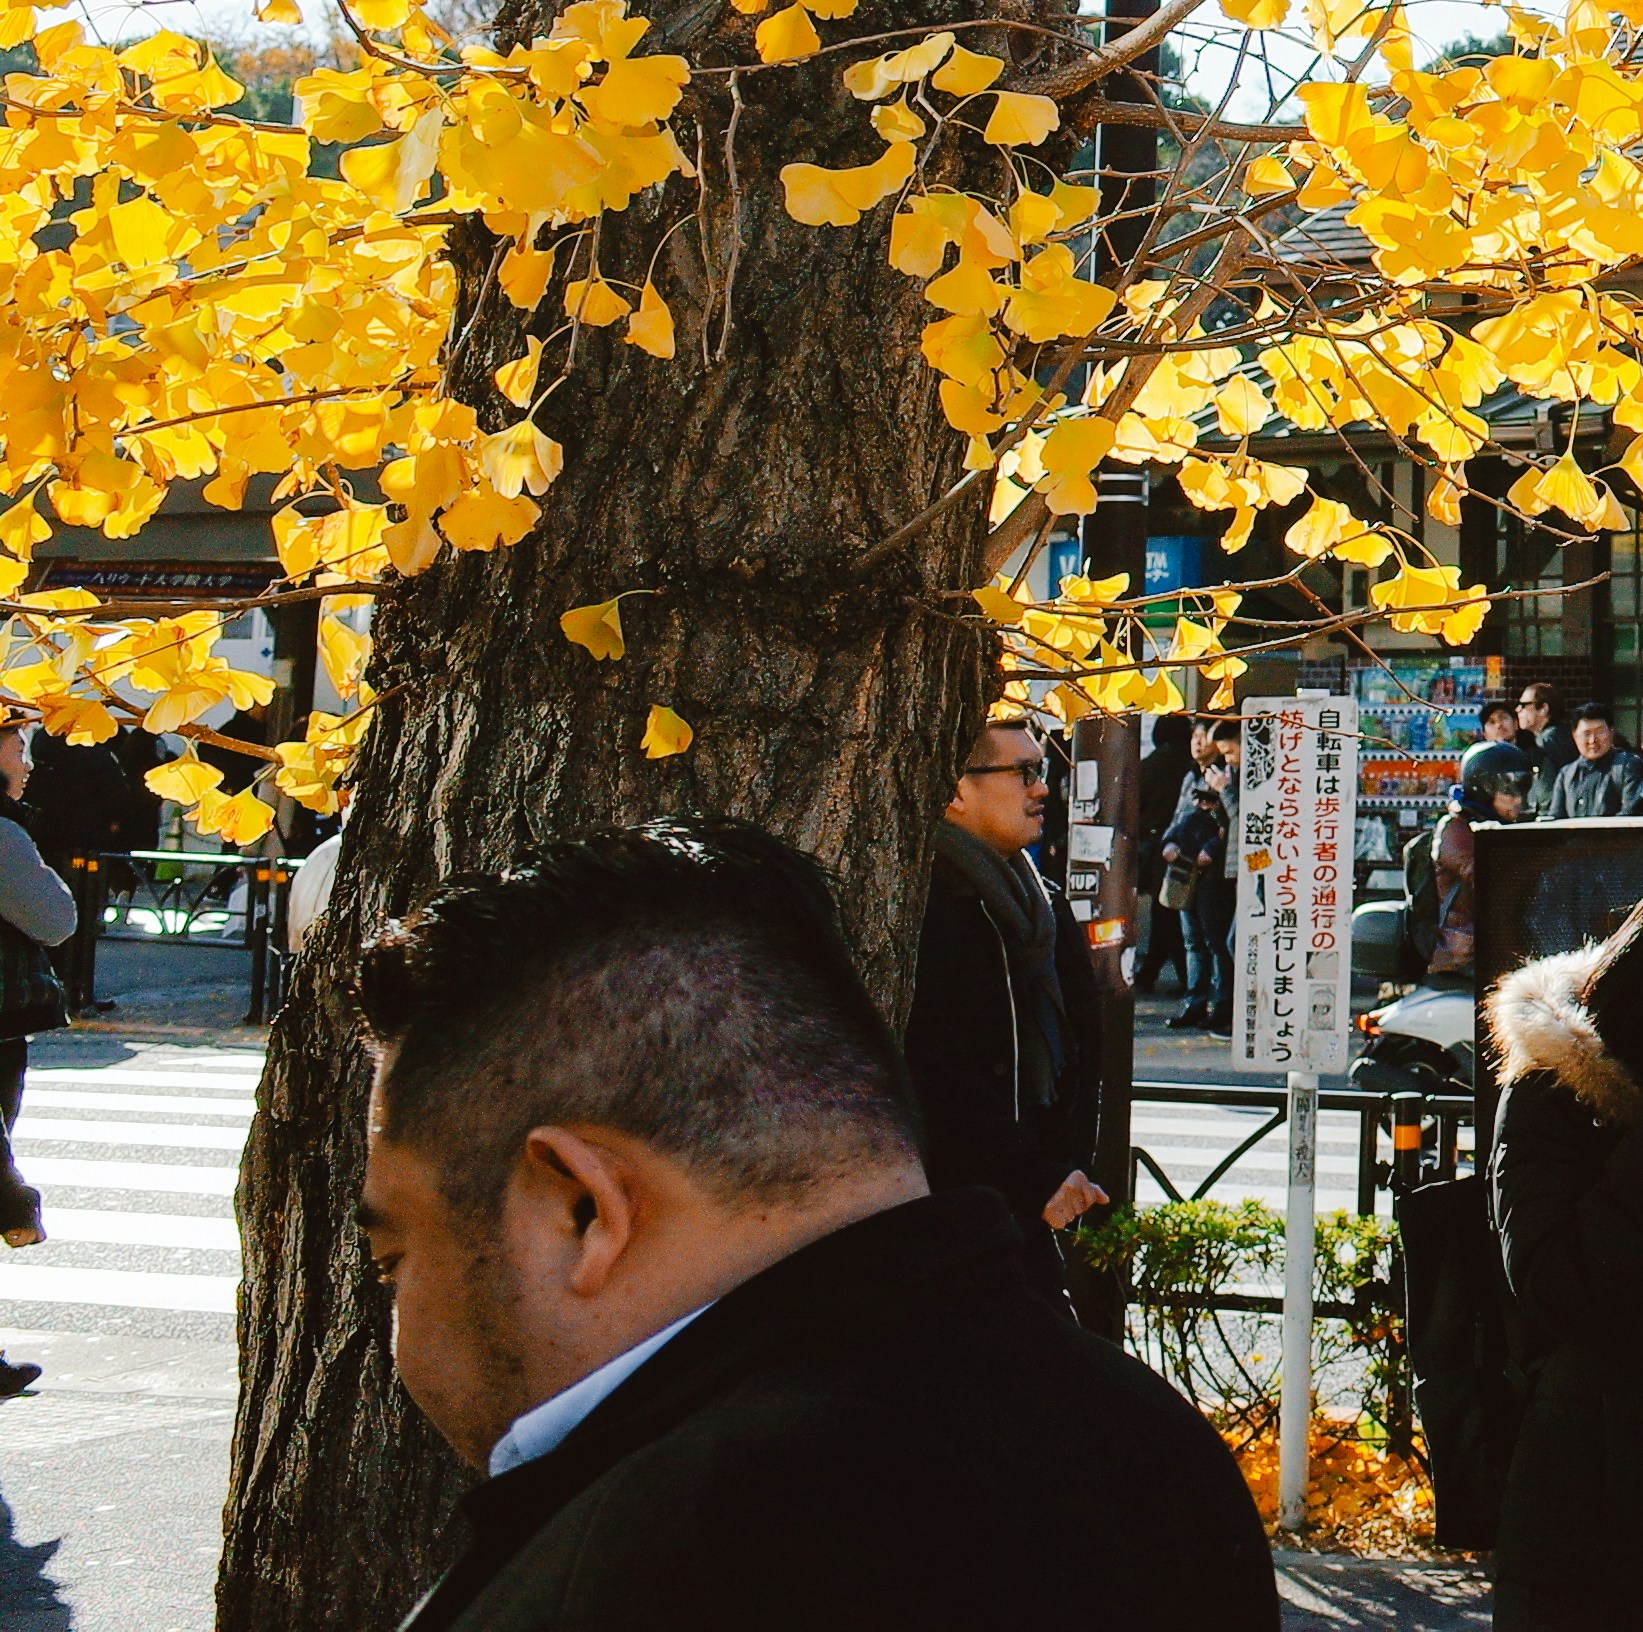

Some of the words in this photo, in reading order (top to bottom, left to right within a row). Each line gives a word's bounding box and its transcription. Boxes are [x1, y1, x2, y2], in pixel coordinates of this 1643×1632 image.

[1145, 551, 1168, 569] TM
[1272, 709, 1304, 1062] 妨げとならないよう通行しましょう
[1311, 709, 1342, 950] 自転車は歩行者の通行の
